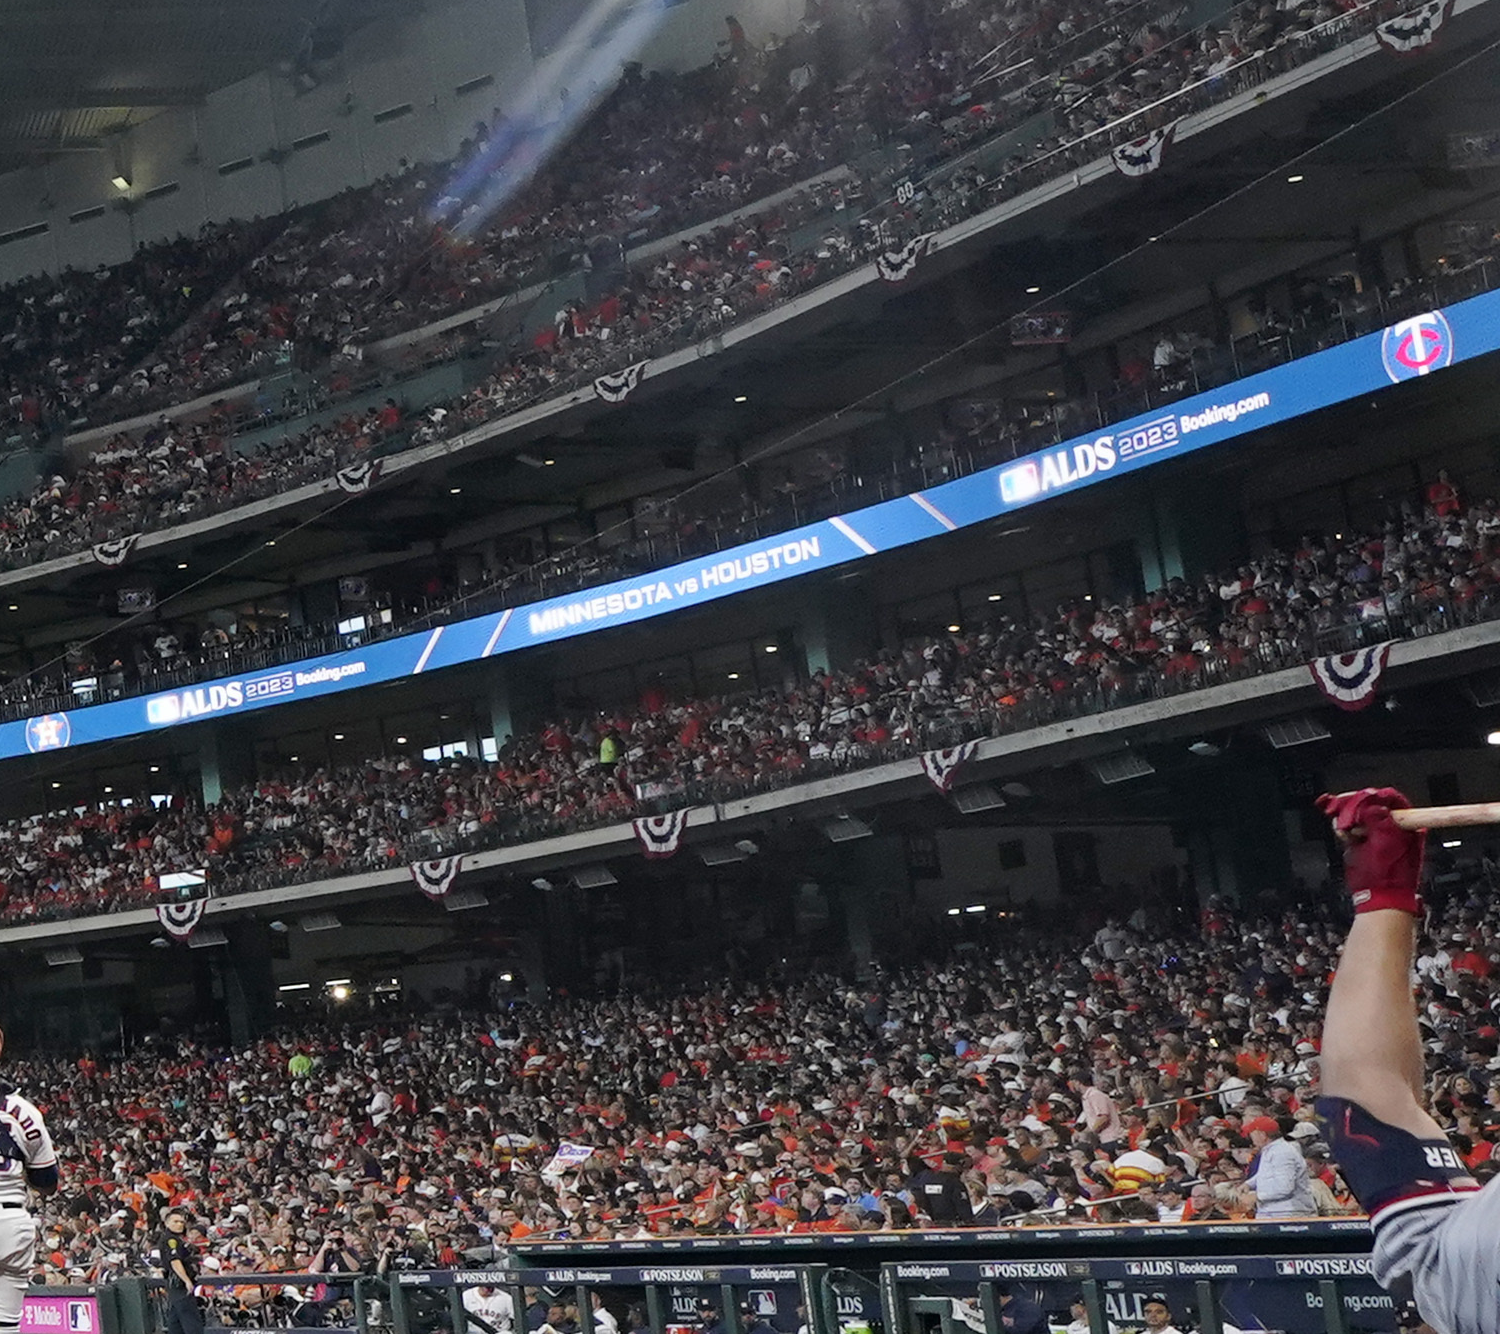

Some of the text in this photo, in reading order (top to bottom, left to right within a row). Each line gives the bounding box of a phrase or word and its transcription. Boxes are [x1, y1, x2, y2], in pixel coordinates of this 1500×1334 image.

[1041, 392, 1270, 492] ALDS 2023 Booking.com
[528, 581, 673, 635] MINNESOTA
[701, 536, 820, 590] HOUSTON
[181, 661, 366, 717] ALDS 2023 Booking.com
[650, 1269, 704, 1282] POSTSEASON
[751, 1268, 797, 1281] Booking.com
[897, 1266, 950, 1278] Booking.com
[994, 1263, 1067, 1278] POSTSEASON
[1141, 1261, 1238, 1276] ALDS Booking.com
[461, 1272, 506, 1283] POSTSEASON
[554, 1271, 575, 1282] ALDS
